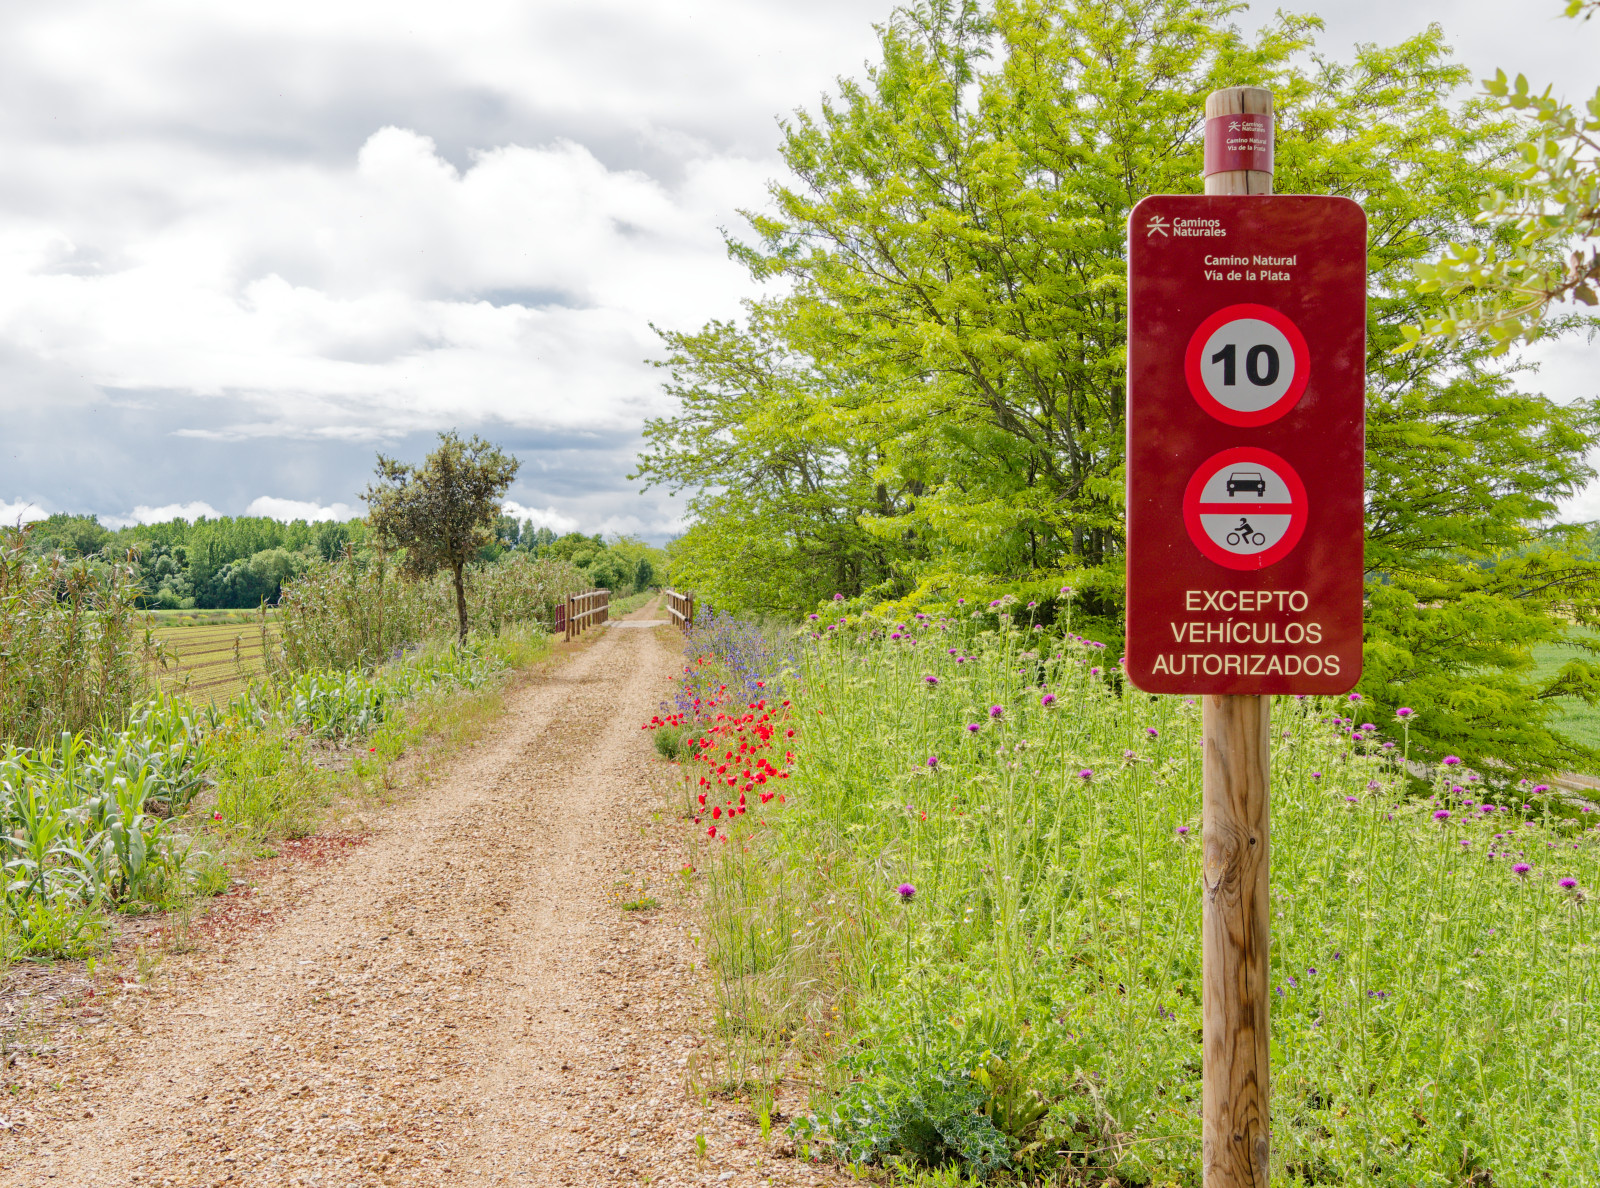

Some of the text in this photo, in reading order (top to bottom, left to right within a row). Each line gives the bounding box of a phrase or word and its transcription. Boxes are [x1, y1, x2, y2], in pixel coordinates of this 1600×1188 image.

[1173, 217, 1220, 228] Caminos
[1173, 228, 1226, 237] Naturales
[1204, 254, 1297, 266] Camino Natural
[1204, 270, 1290, 281] Vía de la Plata
[1211, 344, 1279, 386] 10
[1186, 590, 1308, 612] EXCEPTO
[1170, 618, 1322, 644] VEHÍCULOS
[1152, 654, 1340, 676] AUTORIZADOS
